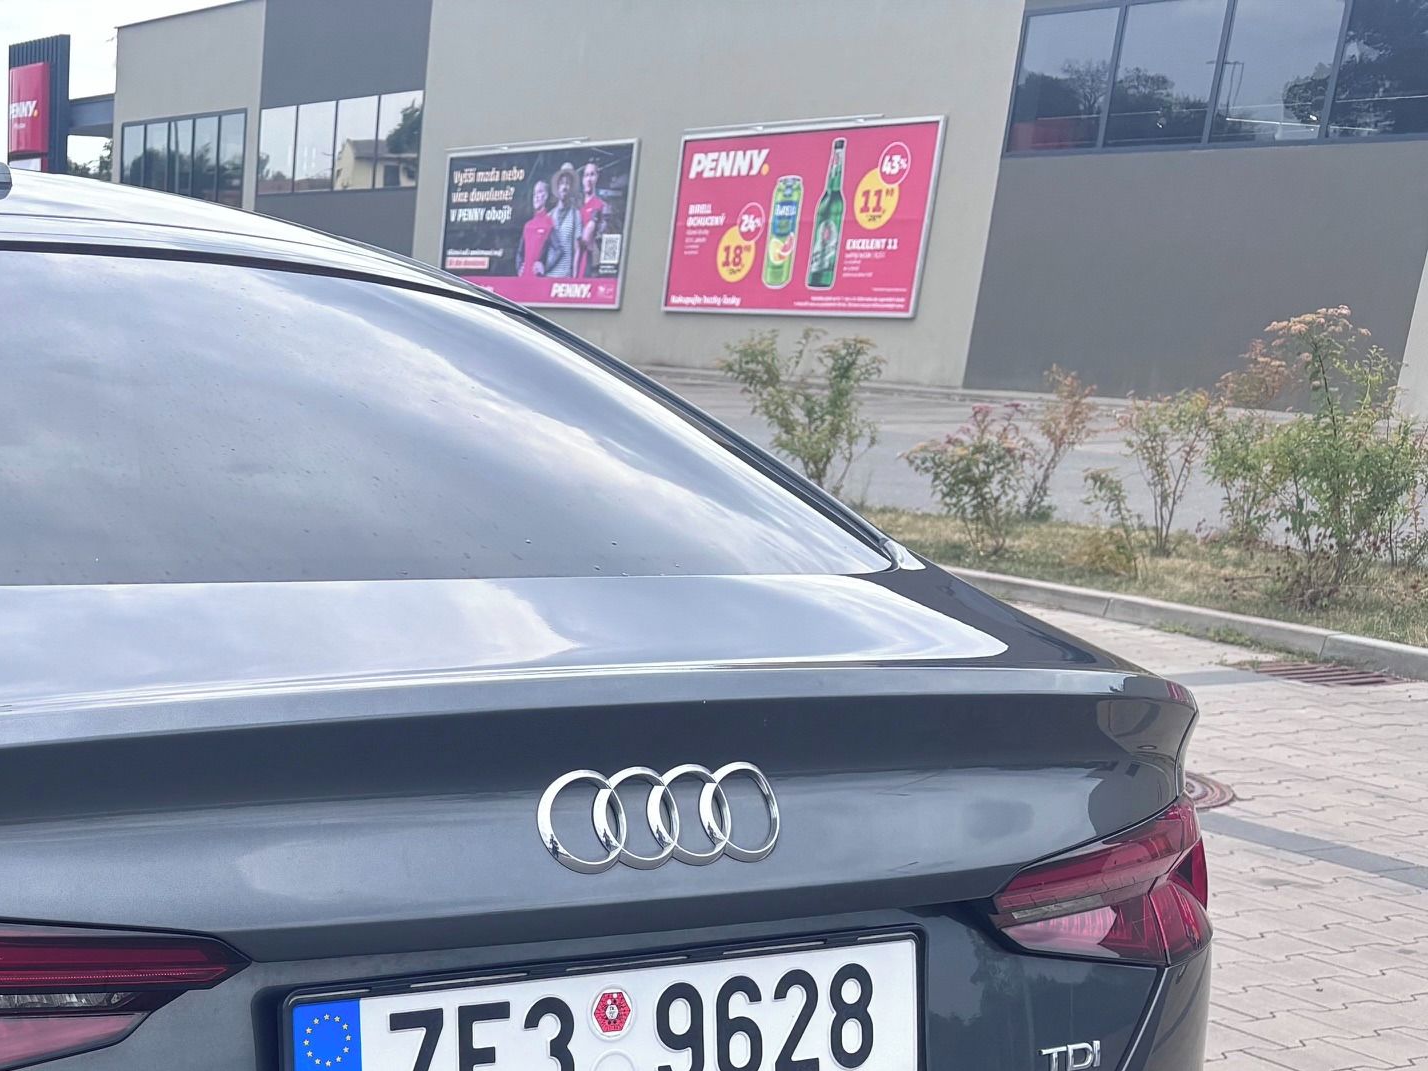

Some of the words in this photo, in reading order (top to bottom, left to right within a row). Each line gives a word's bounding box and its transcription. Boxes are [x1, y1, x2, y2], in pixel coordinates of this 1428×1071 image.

[688, 149, 770, 179] PENNY.
[882, 155, 907, 175] 43%
[476, 167, 500, 182] mzda
[501, 166, 525, 182] nebo
[450, 208, 457, 222] V
[457, 207, 486, 222] PENNY
